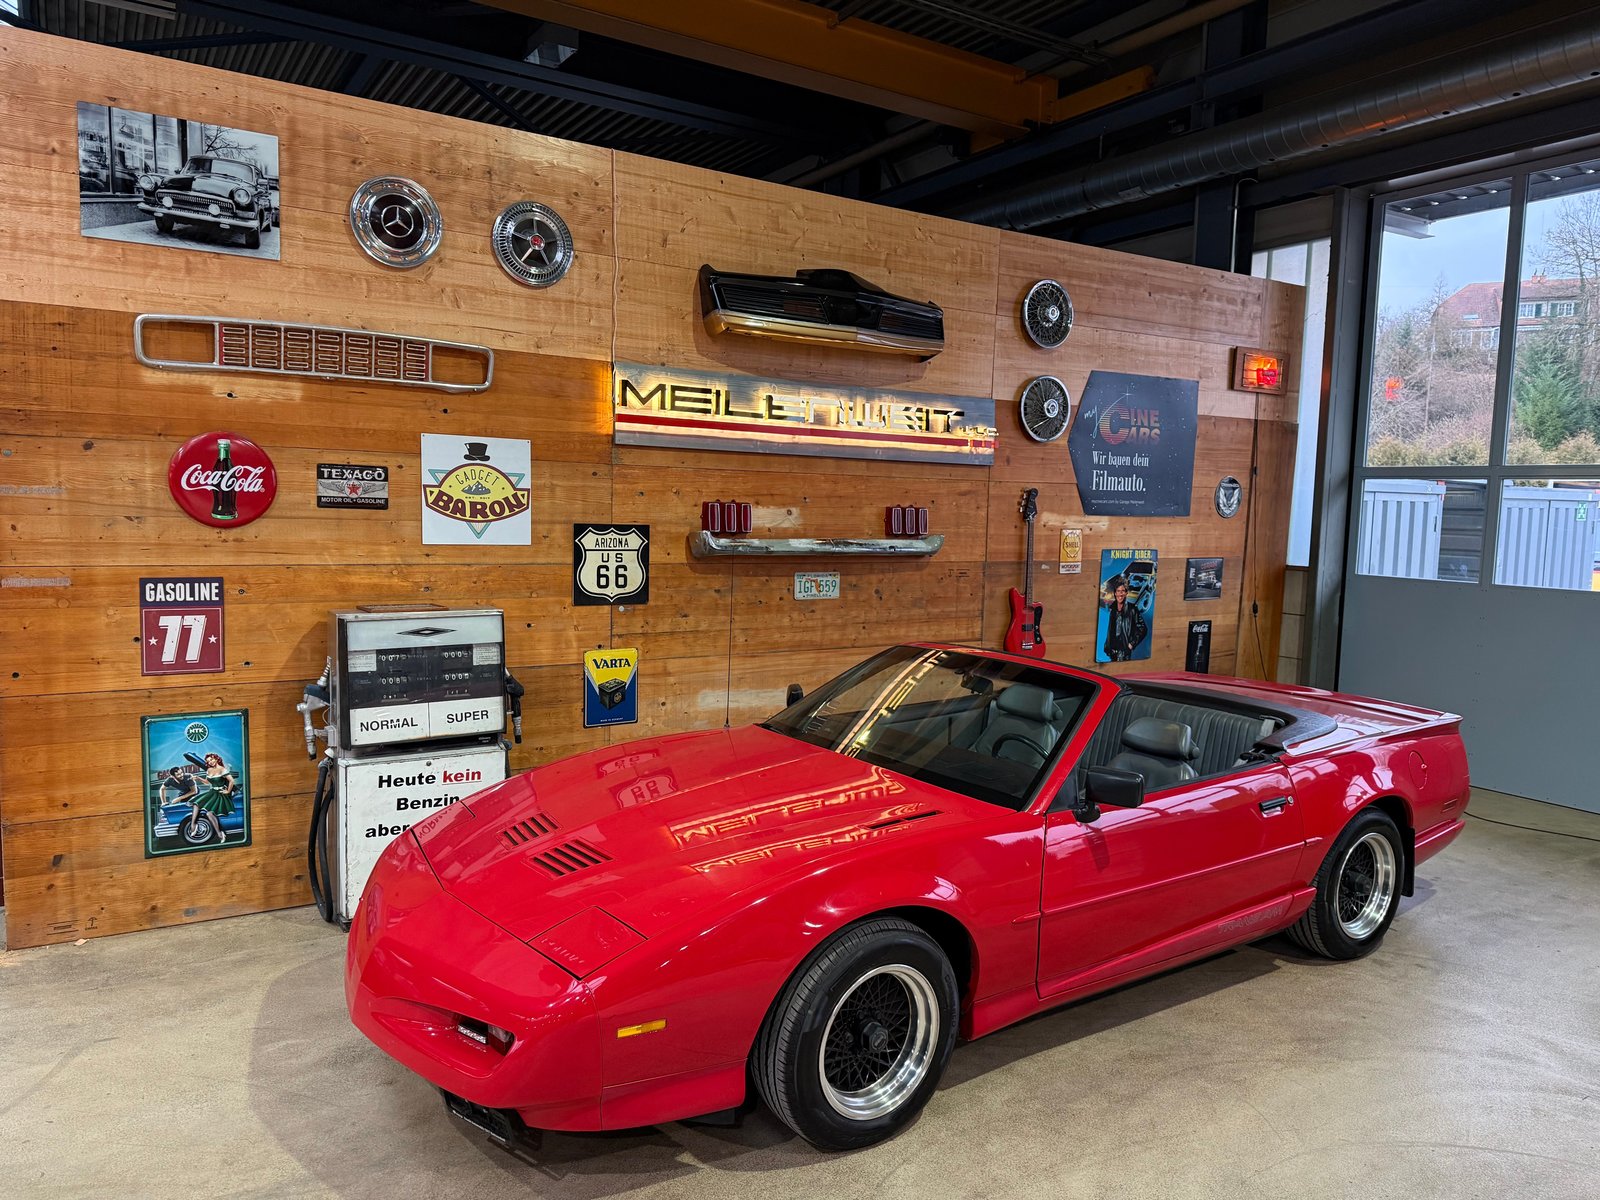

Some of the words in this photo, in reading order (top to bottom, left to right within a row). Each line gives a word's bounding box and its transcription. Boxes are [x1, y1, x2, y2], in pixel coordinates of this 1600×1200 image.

[1092, 451, 1107, 465] Wir
[1108, 452, 1131, 466] bauen
[1132, 453, 1149, 467] dein
[180, 463, 267, 493] Coca-Cola
[320, 468, 385, 480] TEXACO
[455, 468, 500, 486] GADGET
[1092, 470, 1146, 492] Filmauto.
[430, 489, 526, 519] BARON
[595, 537, 629, 548] ARIZONA
[1110, 549, 1133, 559] KNIGHT
[596, 564, 628, 589] 66
[145, 582, 219, 602] GASOLINE
[158, 614, 207, 665] 77
[593, 658, 631, 669] VARTA
[360, 716, 418, 732] NORMAL
[446, 709, 489, 724] SUPER
[378, 772, 436, 788] Heute
[442, 768, 482, 785] kein
[396, 793, 460, 811] Benzin
[365, 823, 411, 838] aber
